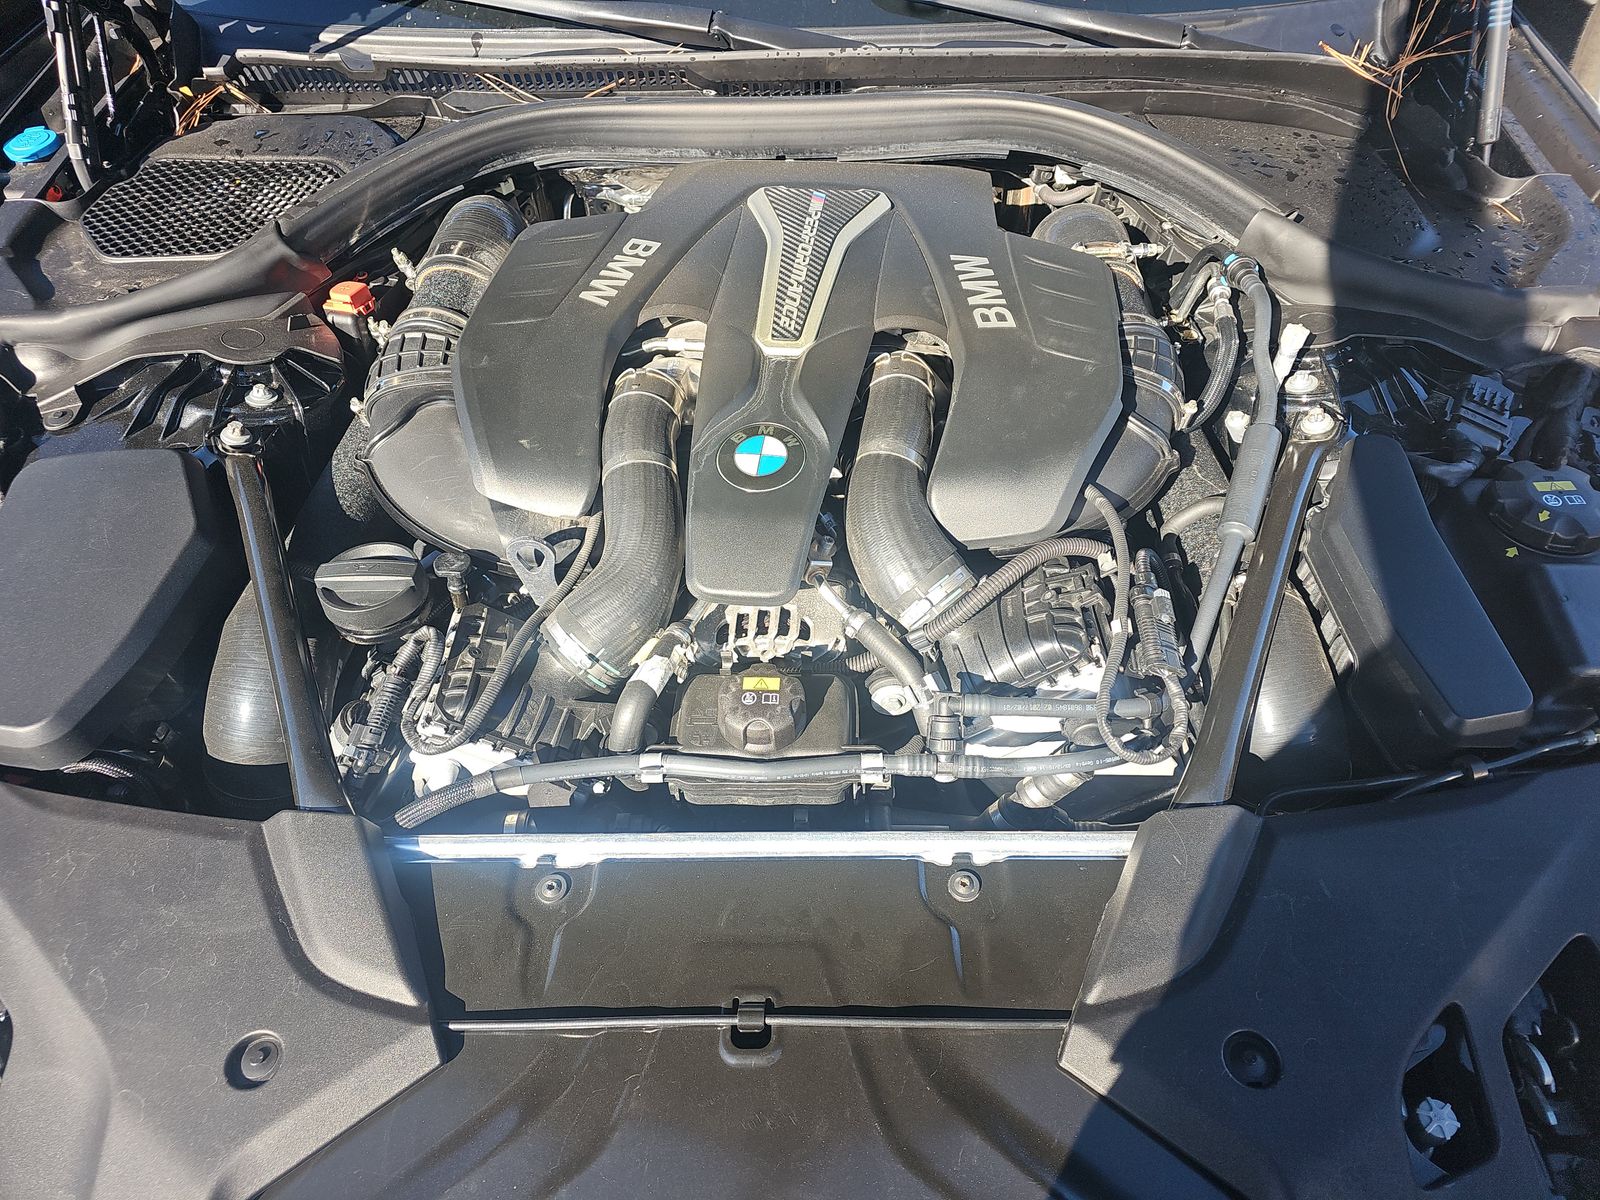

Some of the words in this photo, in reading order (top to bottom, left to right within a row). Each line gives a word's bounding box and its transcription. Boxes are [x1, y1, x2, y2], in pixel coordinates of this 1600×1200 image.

[579, 238, 662, 308] BMW
[780, 211, 821, 332] PERFORMANCE
[950, 254, 1016, 328] BMW
[731, 426, 799, 447] BMW
